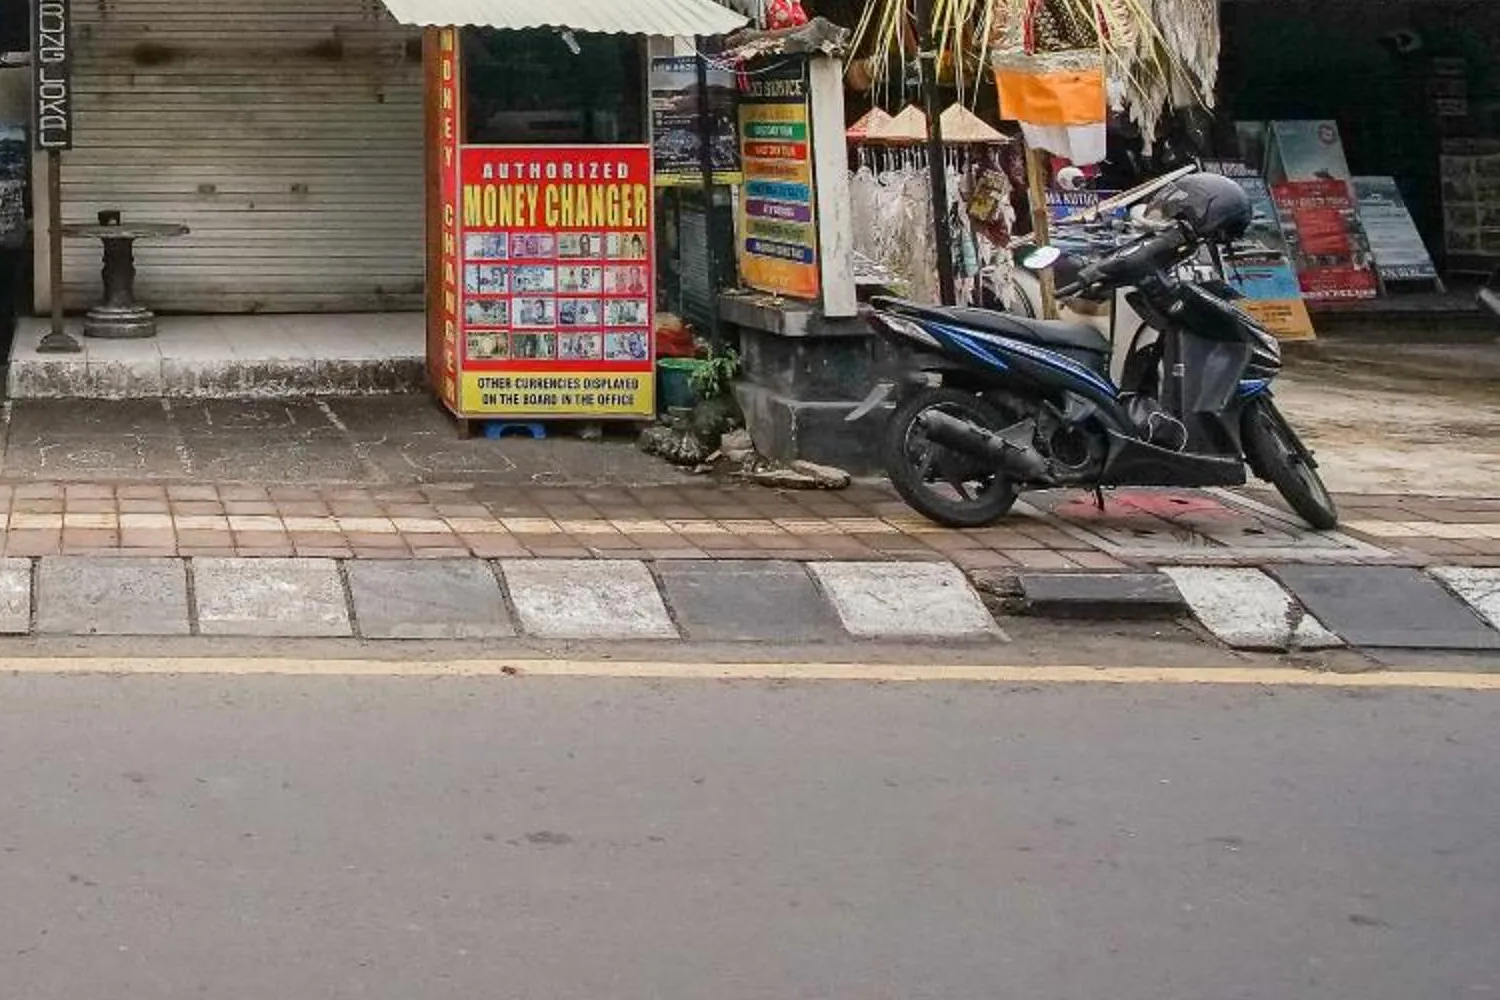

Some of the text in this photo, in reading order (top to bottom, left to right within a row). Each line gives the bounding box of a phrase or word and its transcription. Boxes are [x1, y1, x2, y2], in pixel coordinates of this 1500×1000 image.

[482, 161, 629, 179] AUTHORIZED
[463, 183, 648, 228] MONEY CHANGER
[477, 377, 639, 390] OTHER CURRENCIES DISPLAYED
[483, 394, 635, 406] ON THE BOARD IN THE OFFICE
